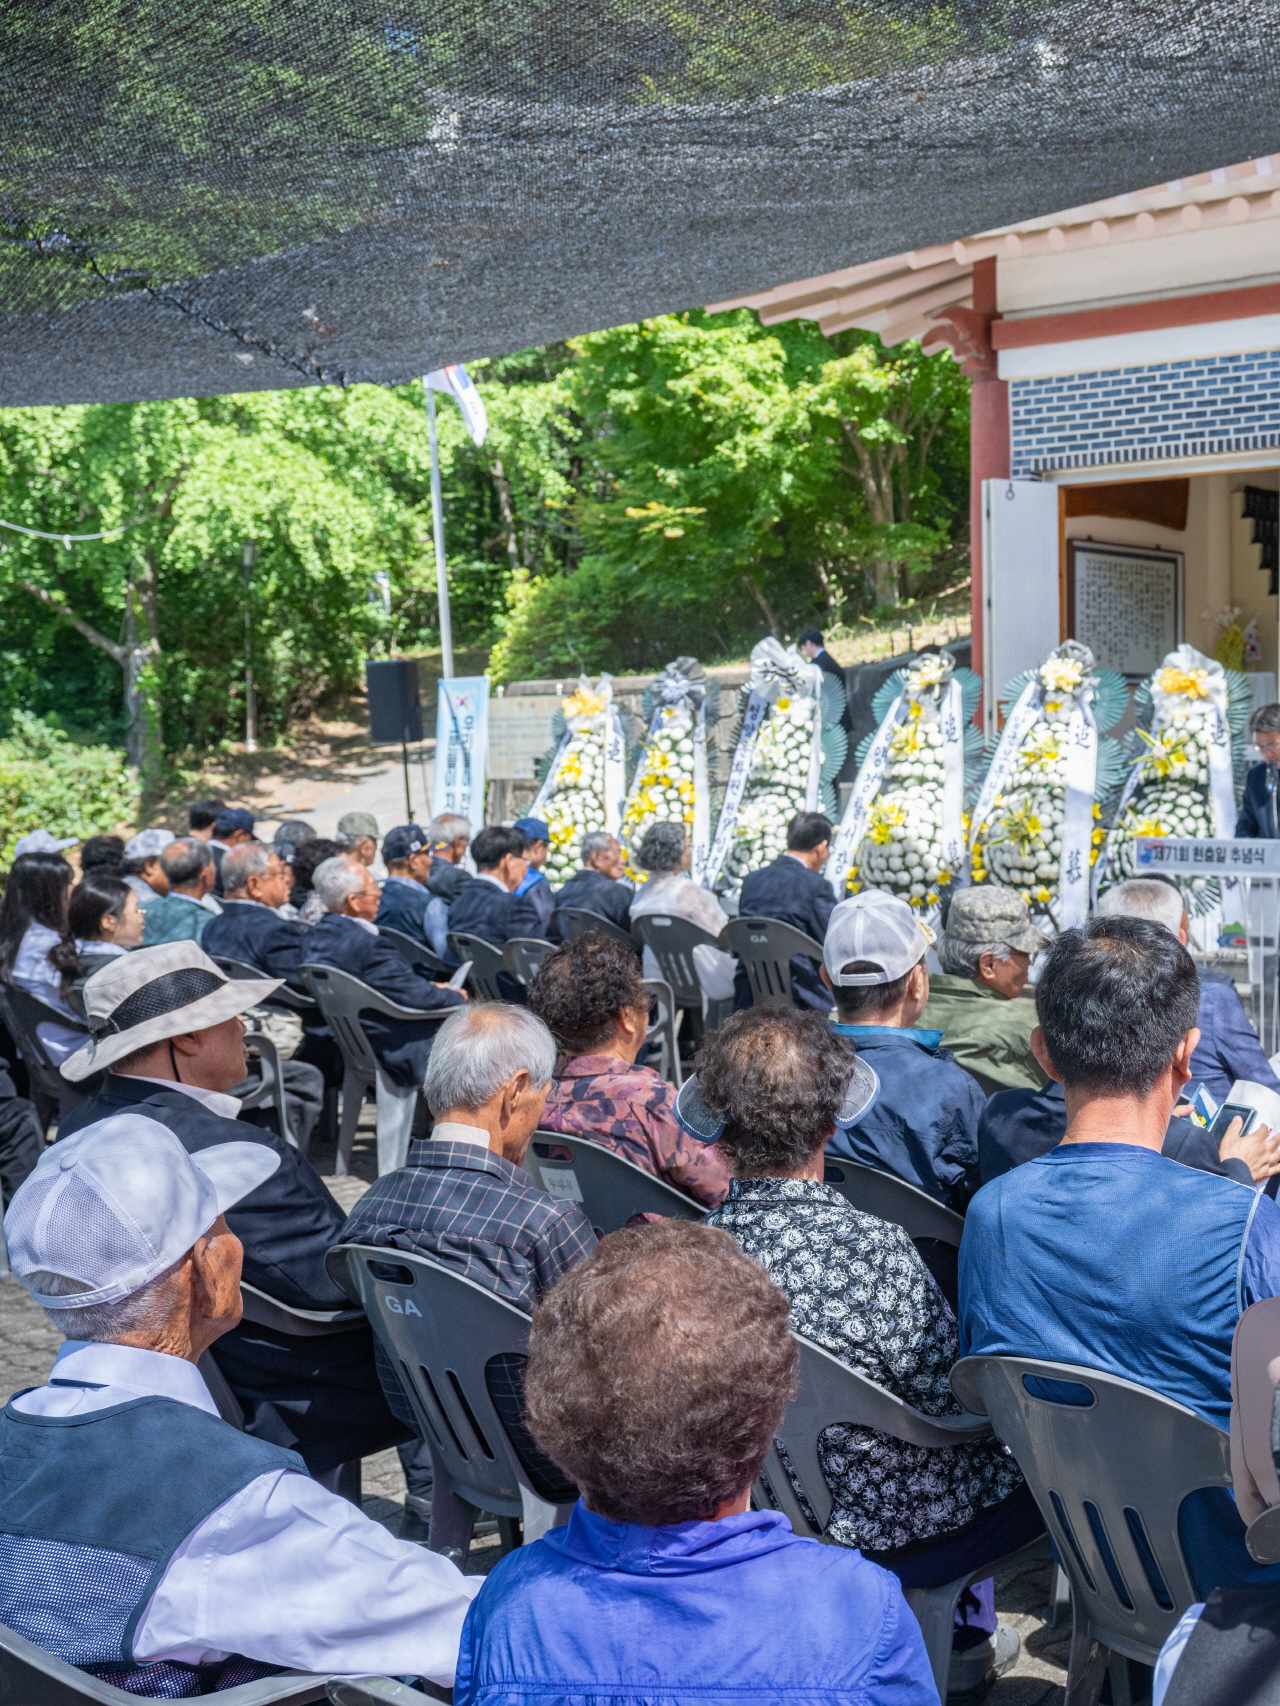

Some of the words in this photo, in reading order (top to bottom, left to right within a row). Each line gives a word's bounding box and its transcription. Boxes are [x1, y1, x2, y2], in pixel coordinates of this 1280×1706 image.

[1154, 845, 1189, 863] 제71회
[1194, 846, 1227, 863] 현충일
[1231, 847, 1265, 864] 추념식
[385, 1295, 423, 1318] GA
